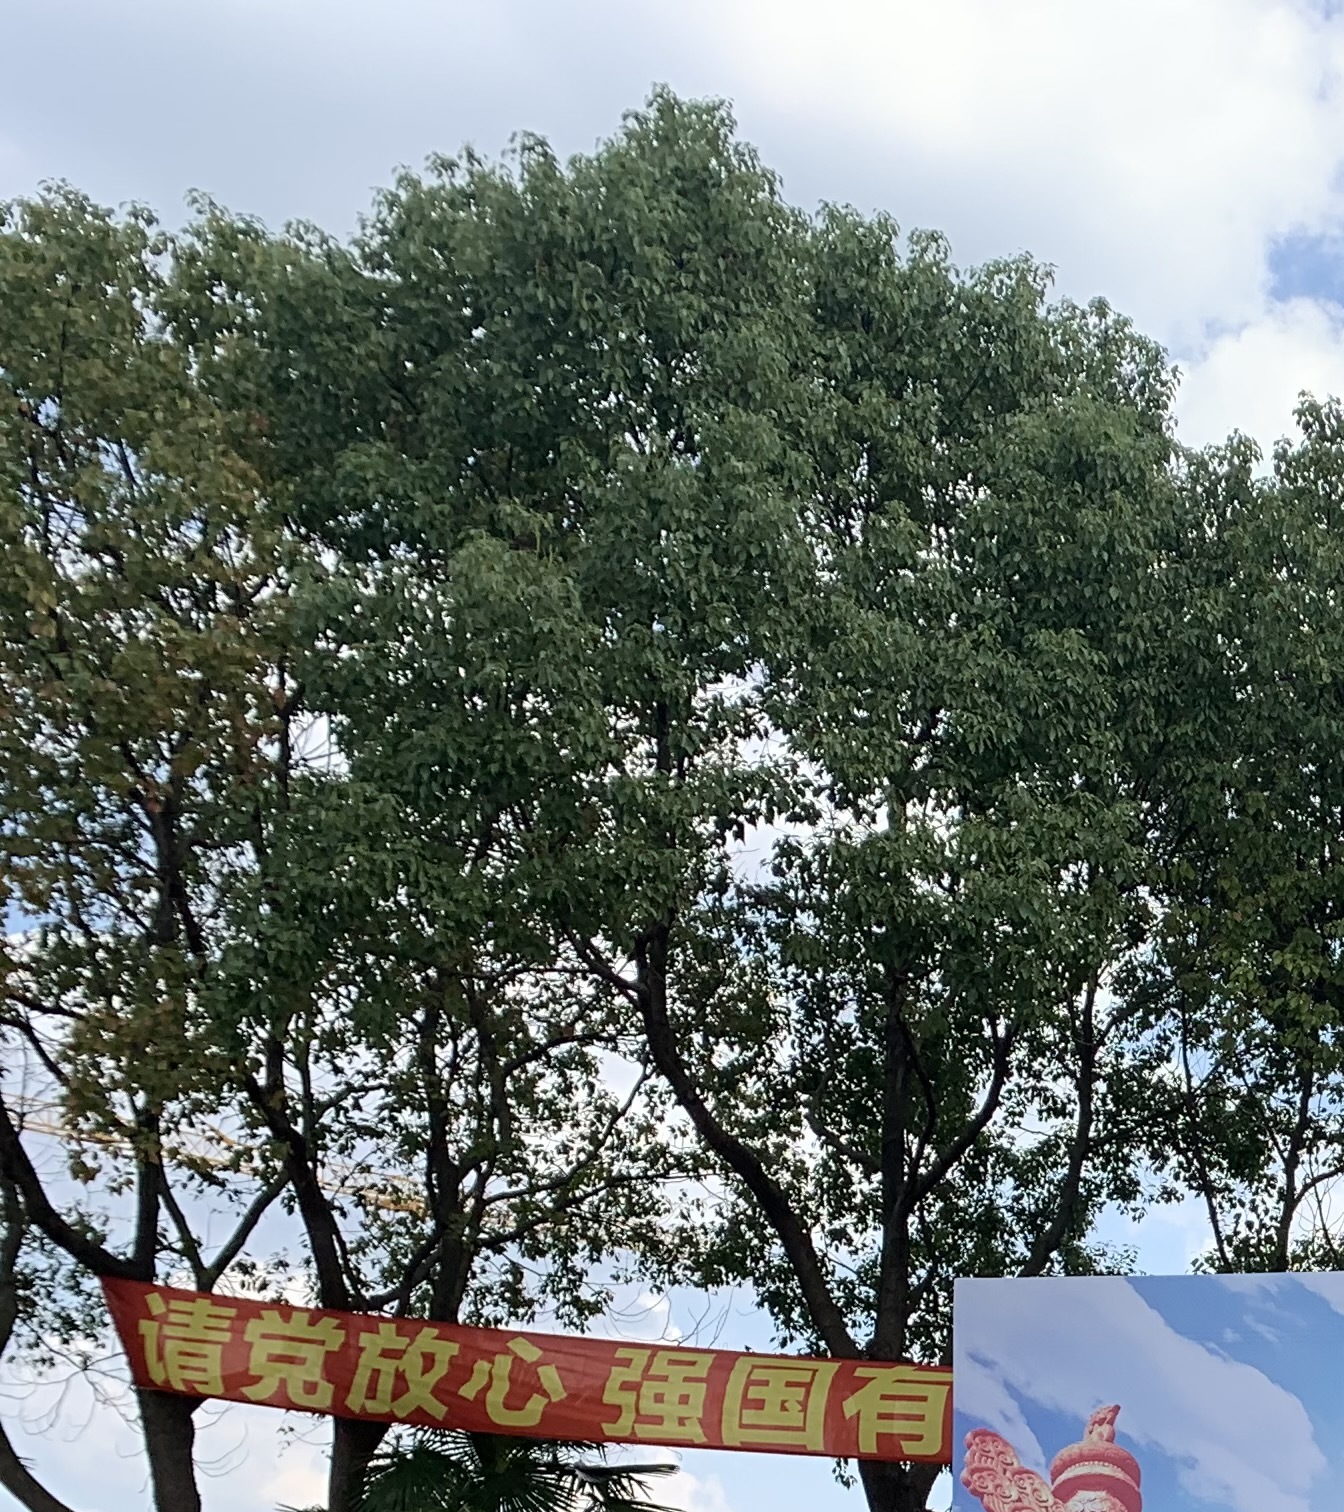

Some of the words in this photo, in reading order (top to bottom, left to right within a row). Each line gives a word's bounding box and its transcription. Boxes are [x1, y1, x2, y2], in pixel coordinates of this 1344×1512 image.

[137, 1292, 568, 1427] 请党放心
[599, 1346, 953, 1456] 强国有
